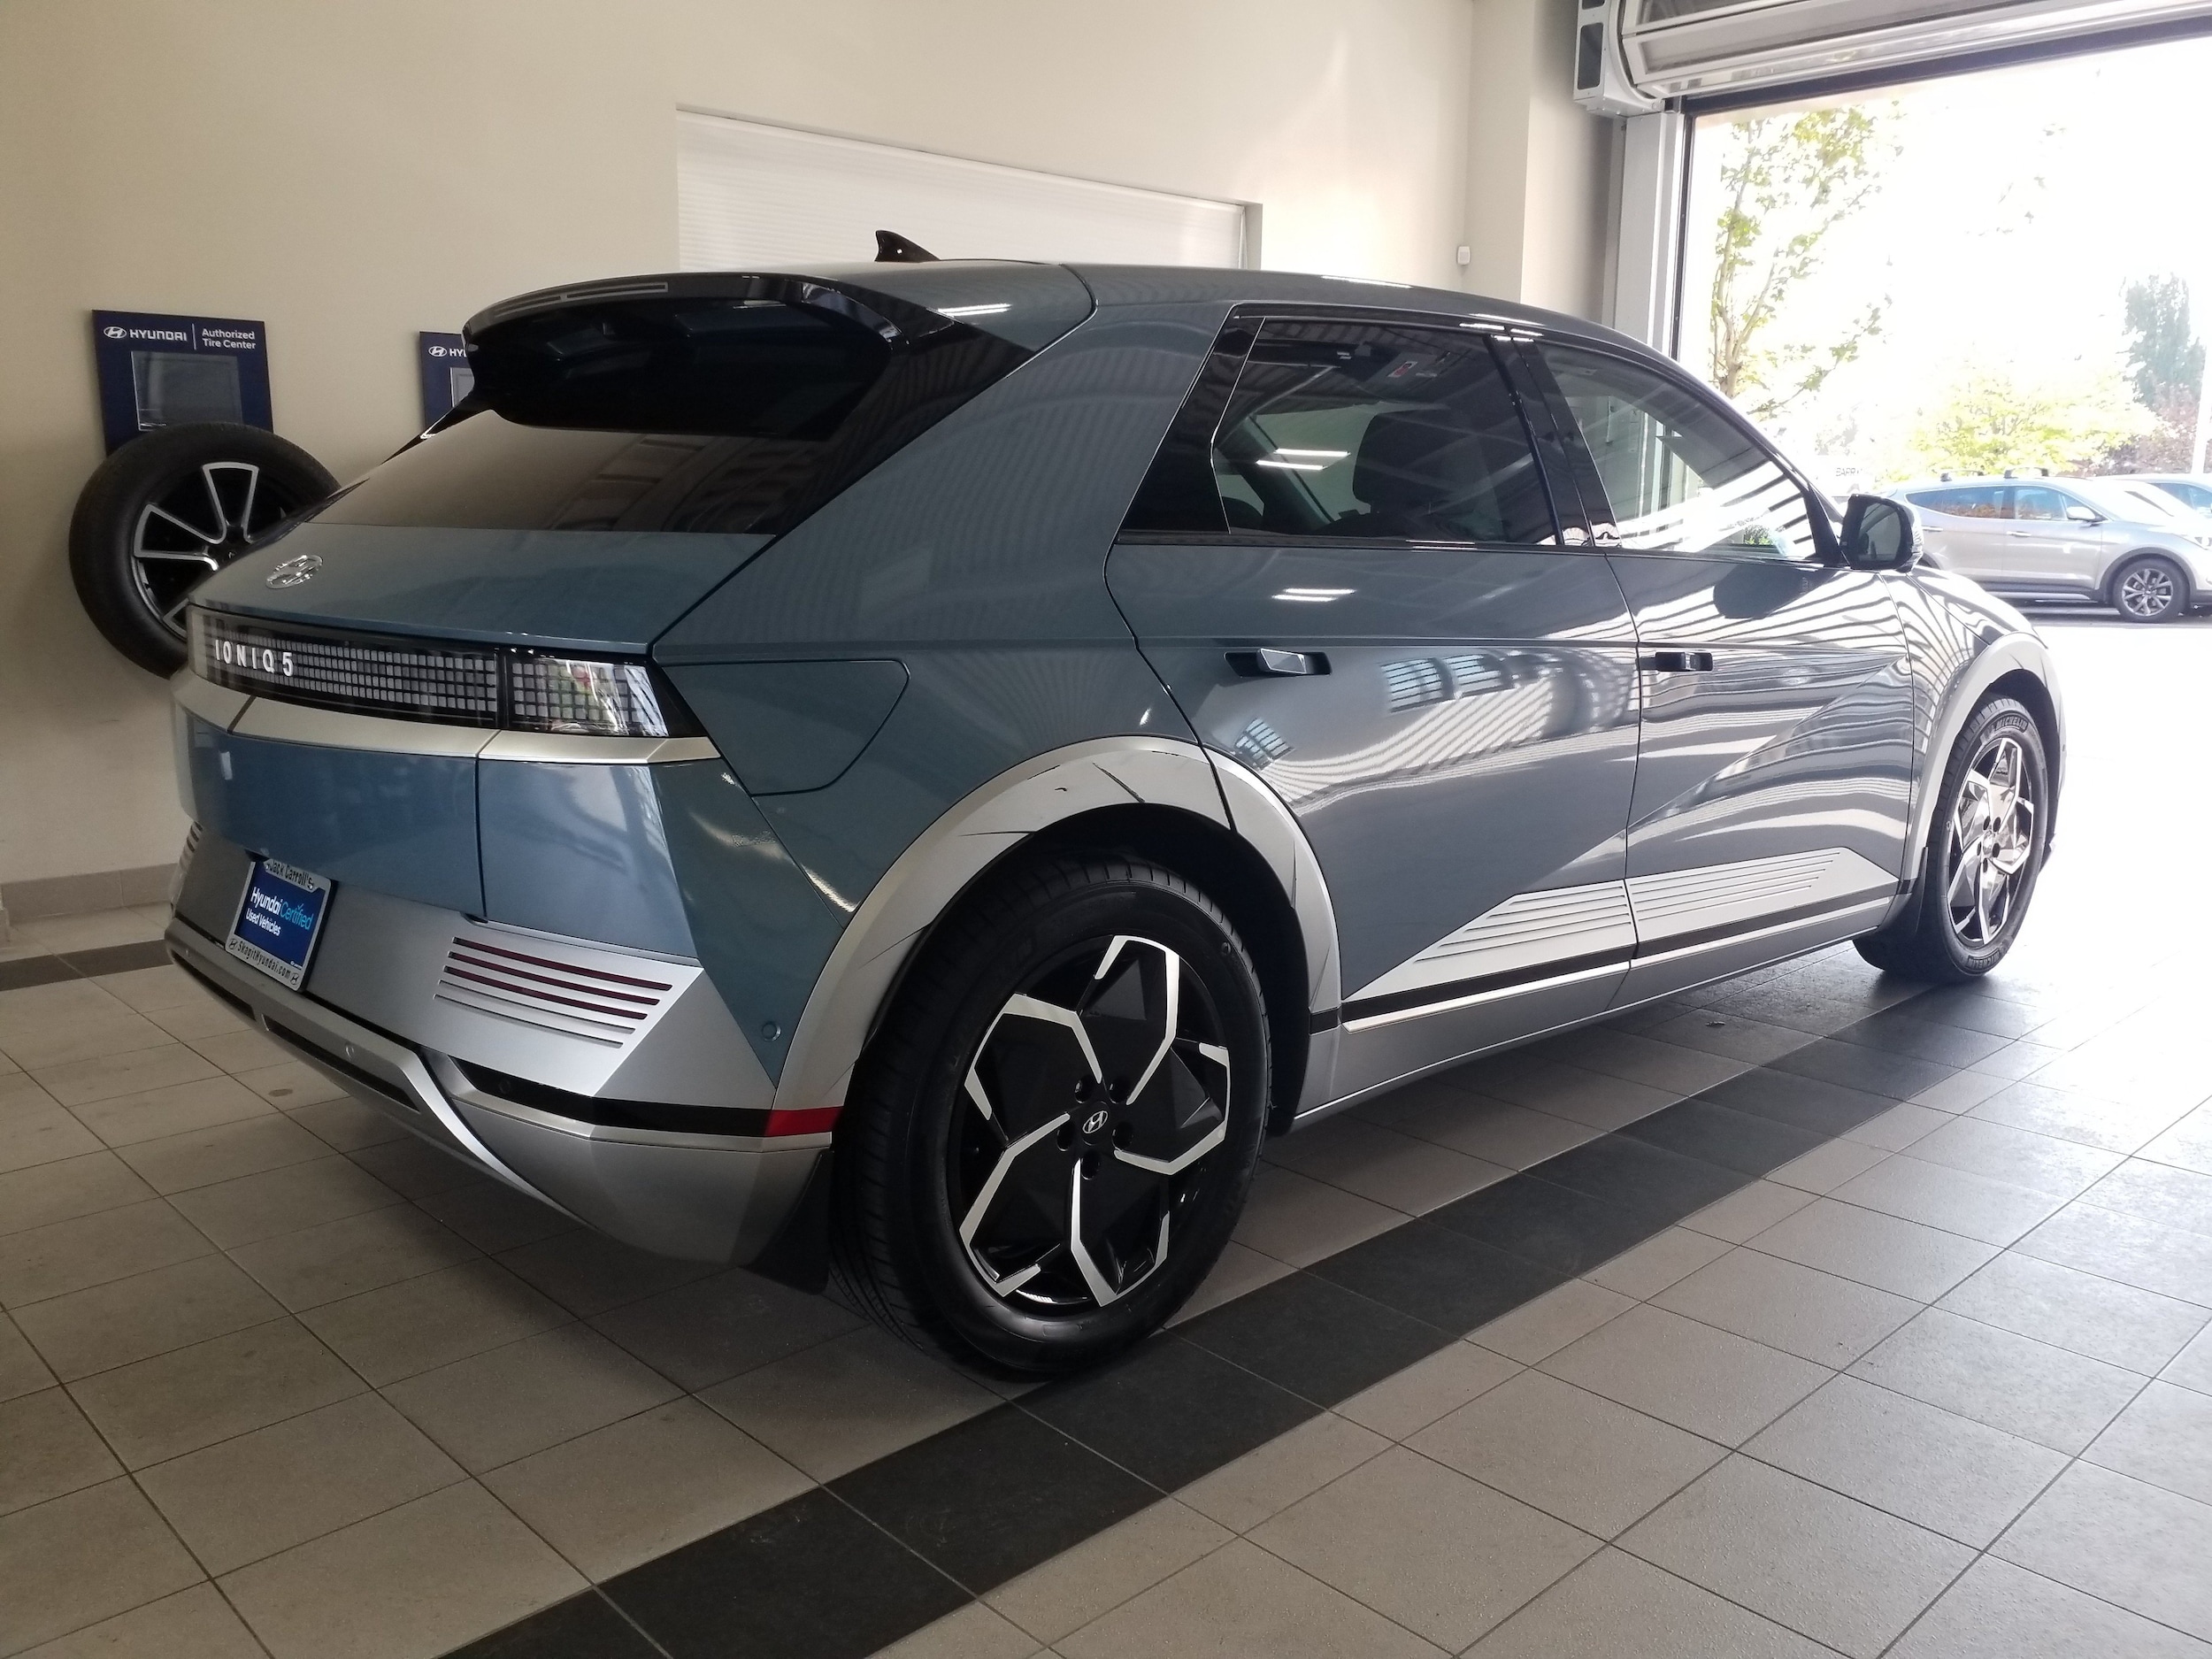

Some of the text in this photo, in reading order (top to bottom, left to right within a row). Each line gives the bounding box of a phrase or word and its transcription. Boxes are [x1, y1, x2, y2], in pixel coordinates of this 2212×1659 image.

[129, 328, 188, 342] HYUNDAI
[202, 328, 256, 340] Authorized
[203, 338, 257, 349] Tire Center
[215, 639, 294, 677] IONIQ 5
[245, 908, 281, 937] Used Vehicles
